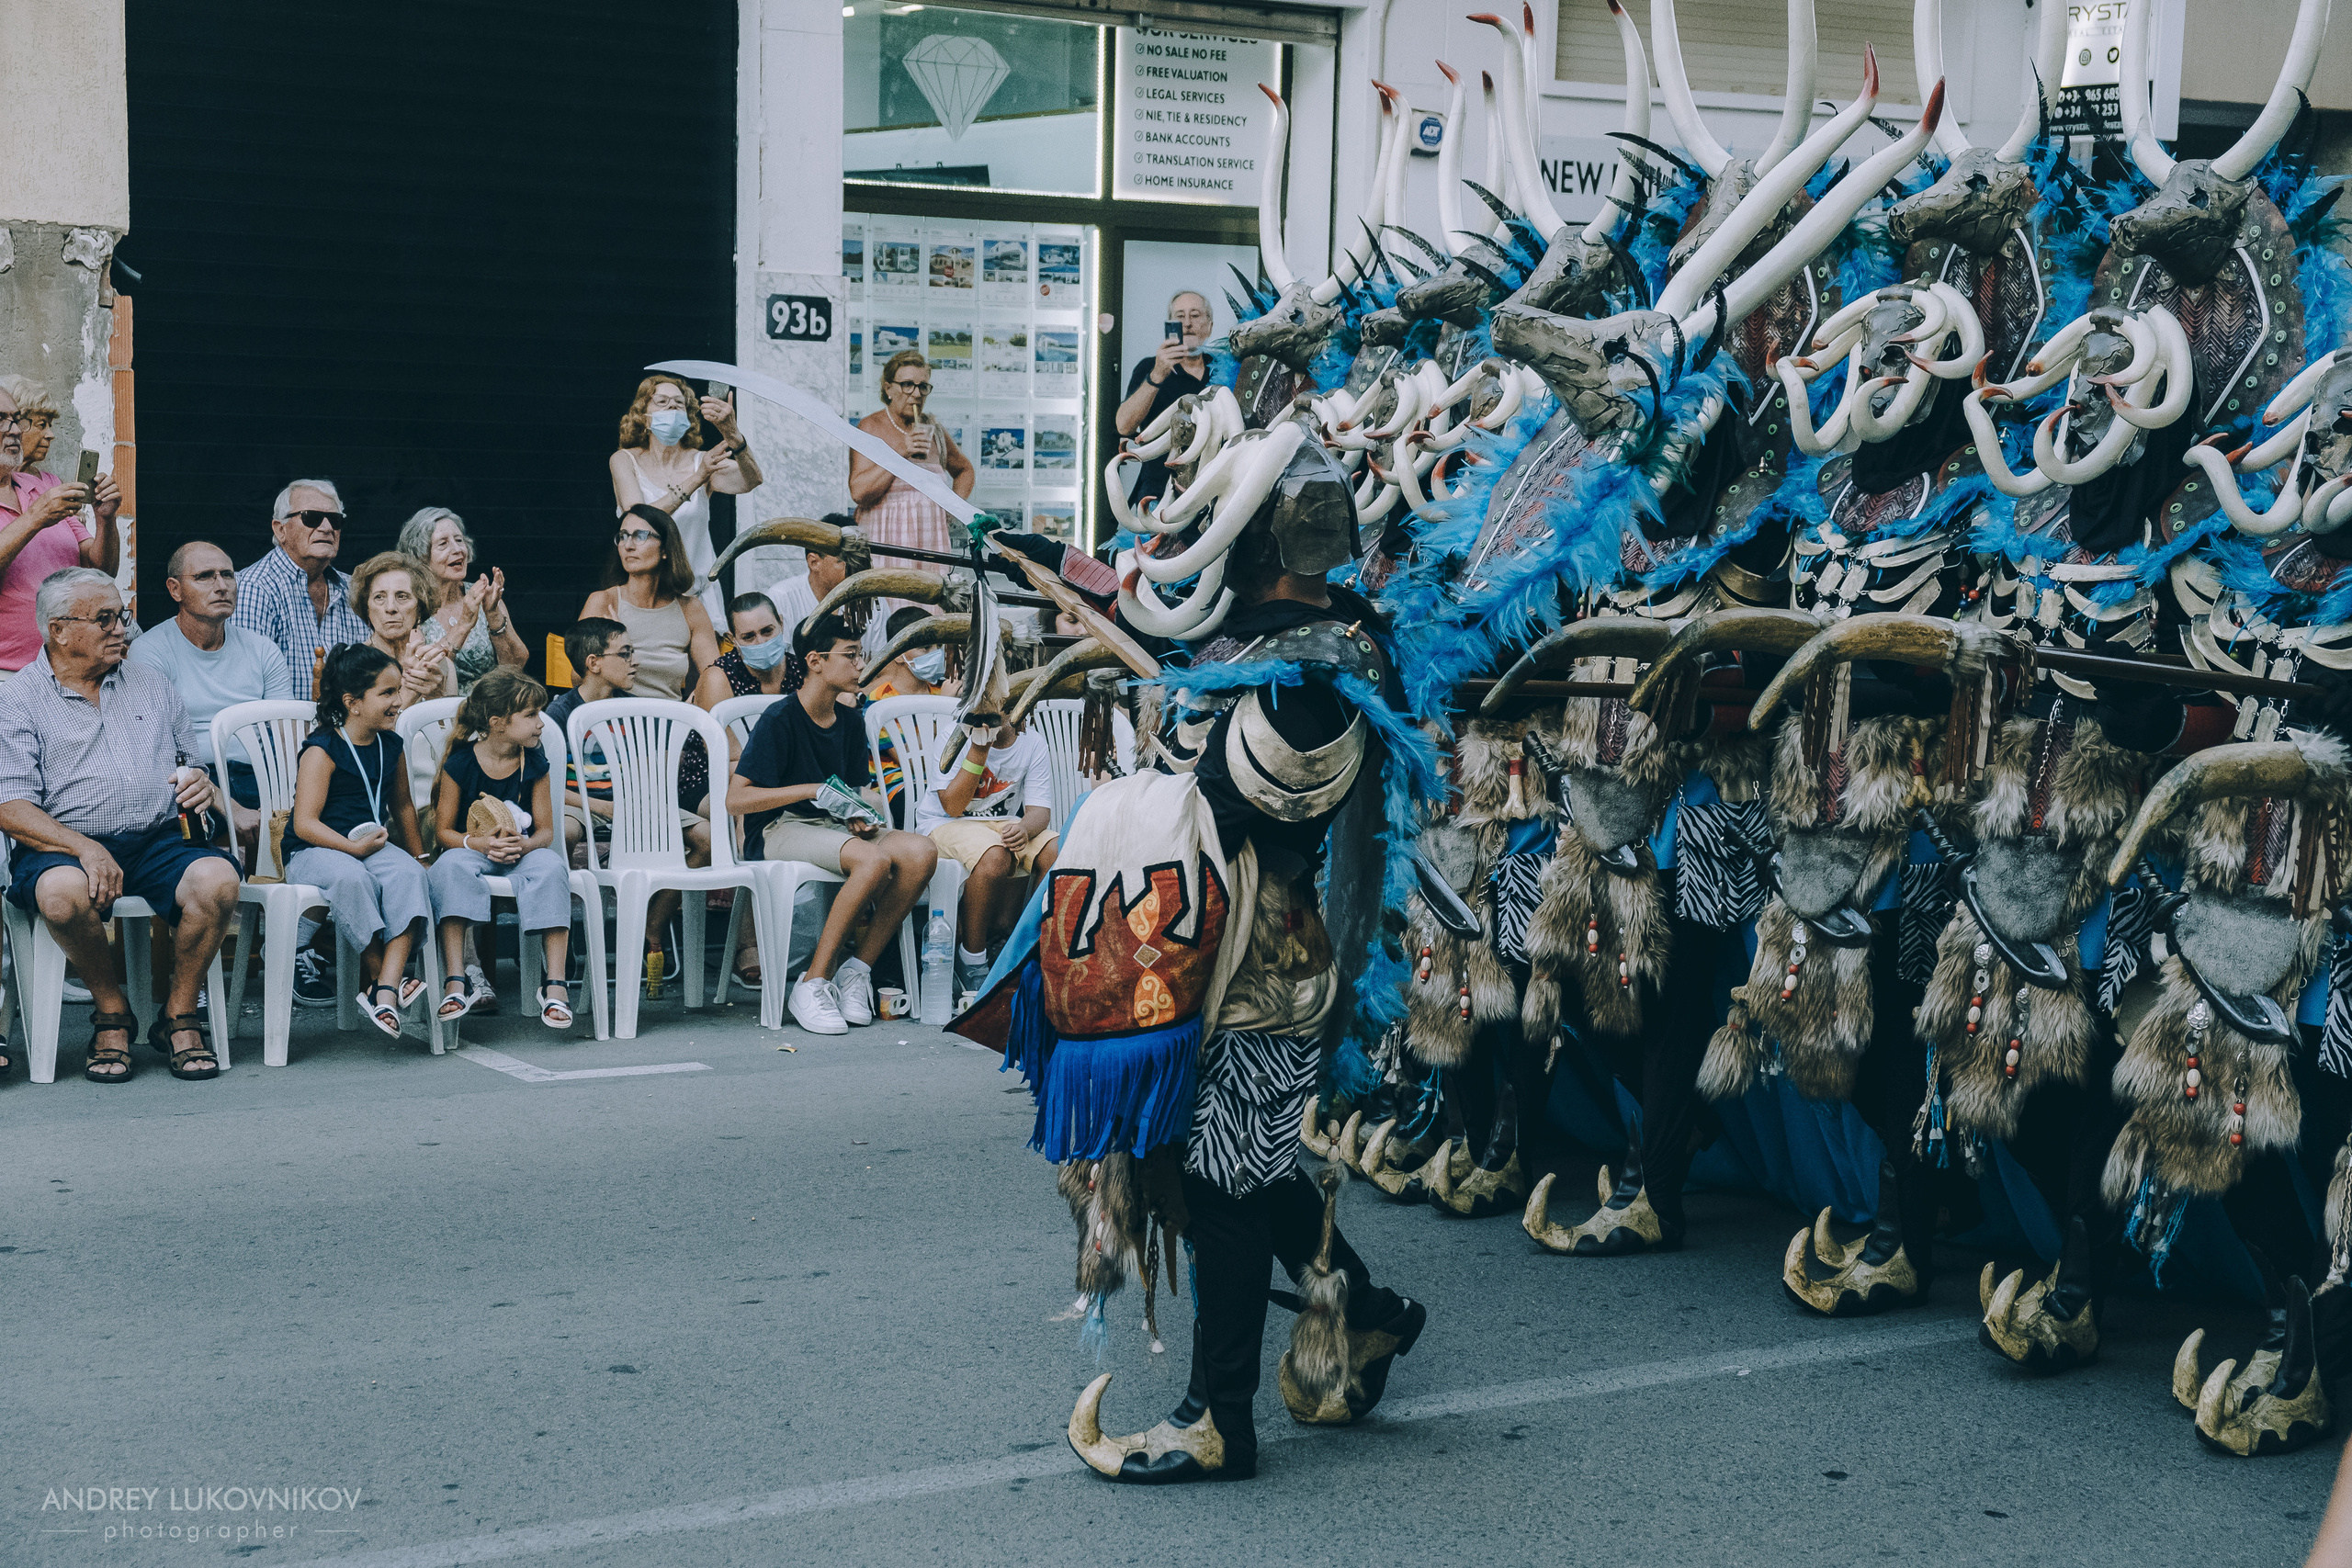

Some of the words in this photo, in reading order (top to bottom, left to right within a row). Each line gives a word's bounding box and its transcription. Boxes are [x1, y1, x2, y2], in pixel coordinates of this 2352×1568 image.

[2069, 2, 2128, 22] RYST
[1148, 45, 1162, 56] NO
[1166, 46, 1188, 58] SALE
[1193, 49, 1207, 59] NO
[1210, 50, 1226, 61] FEE
[1147, 66, 1169, 78] FREE
[1171, 68, 1227, 82] VALUATION
[1147, 89, 1177, 100] LEGAL
[1182, 91, 1224, 103] SERVICES
[2065, 89, 2082, 104] +3
[2085, 88, 2101, 102] 965
[1146, 110, 1164, 122] NIE,
[1167, 112, 1181, 122] TIE
[1184, 113, 1190, 122] &
[1194, 114, 1247, 126] RESIDENCY
[1146, 132, 1173, 142] BANK
[1175, 134, 1229, 146] ACCOUNTS
[1422, 125, 1441, 138] ADT
[1147, 153, 1214, 166] TRANSLATION
[1217, 158, 1253, 169] SERVICE
[1146, 175, 1173, 186] HOME
[1177, 177, 1233, 189] INSURANCE
[1541, 159, 1604, 195] NEW
[772, 300, 827, 336] 93b
